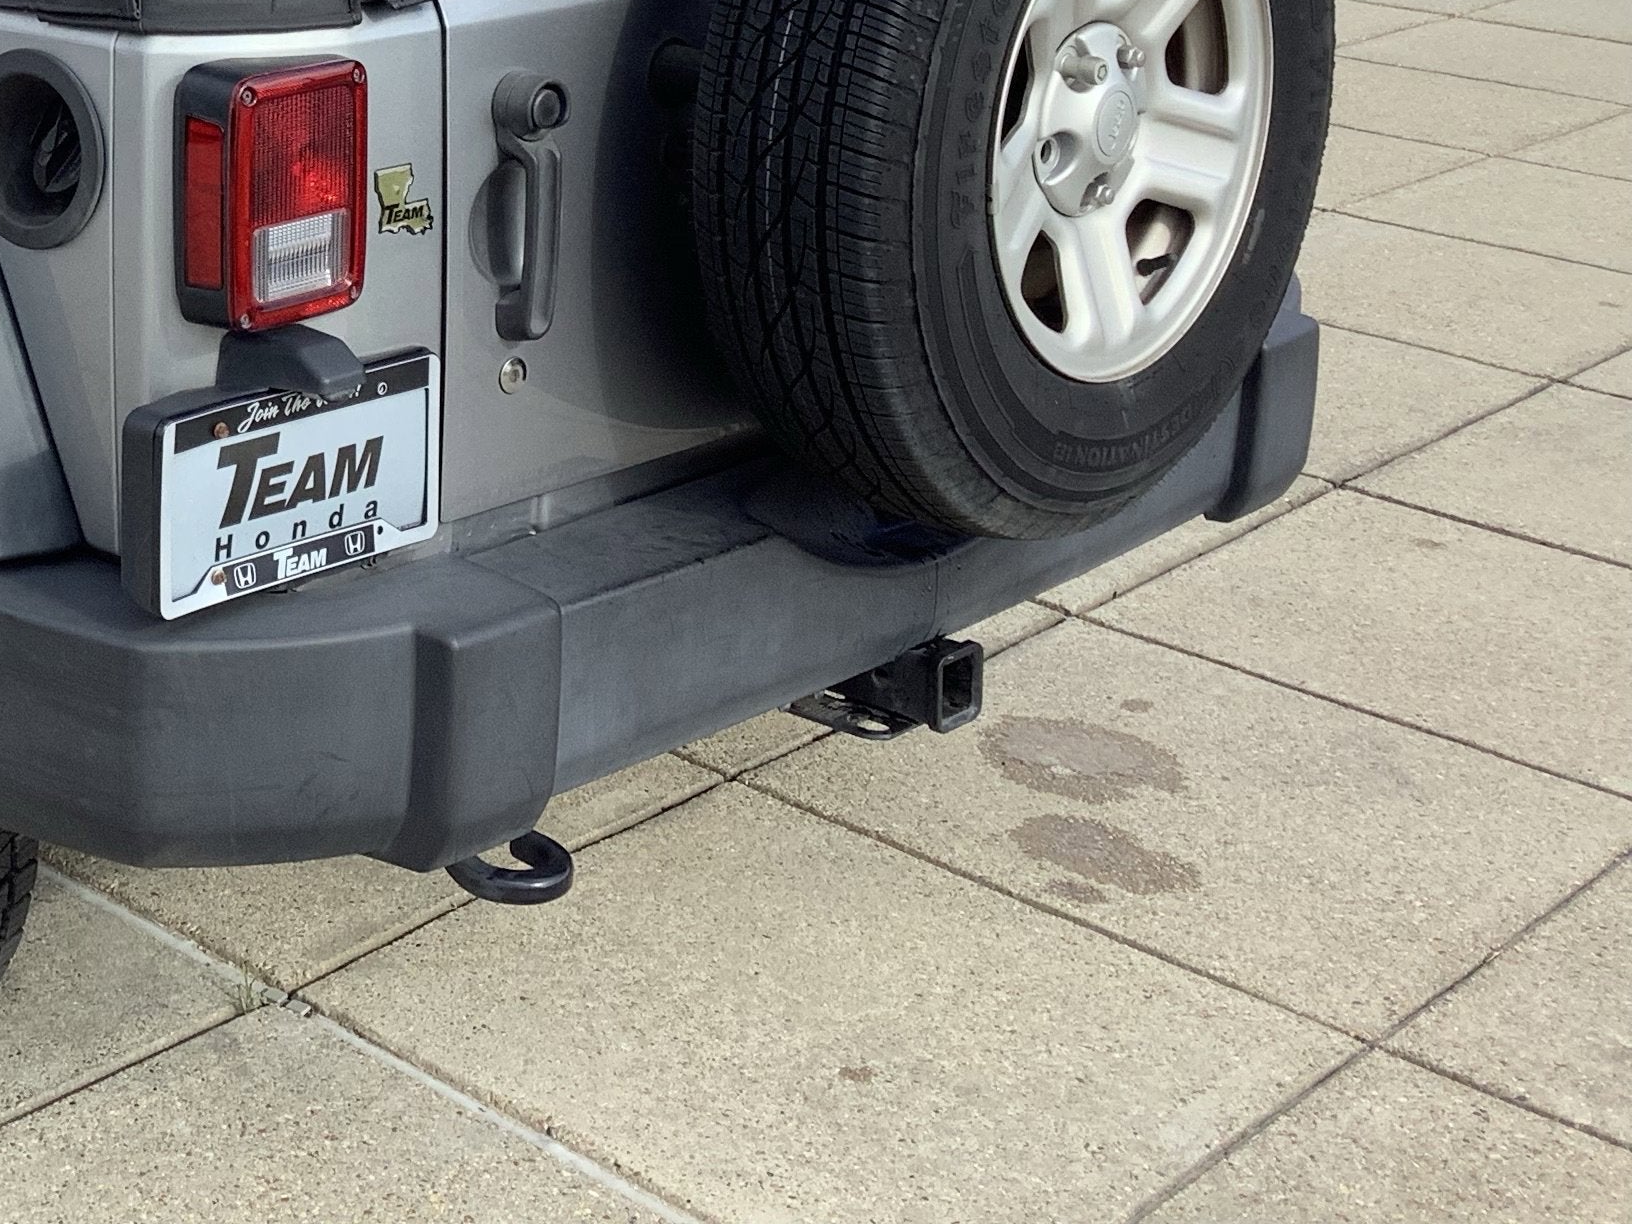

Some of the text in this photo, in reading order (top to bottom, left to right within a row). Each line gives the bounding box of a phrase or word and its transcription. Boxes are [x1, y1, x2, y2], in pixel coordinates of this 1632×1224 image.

[384, 203, 424, 225] TEAM
[237, 401, 279, 434] Join
[282, 392, 312, 417] The
[217, 431, 384, 529] TEAM
[214, 499, 378, 563] Honda
[273, 546, 327, 580] TEAM
